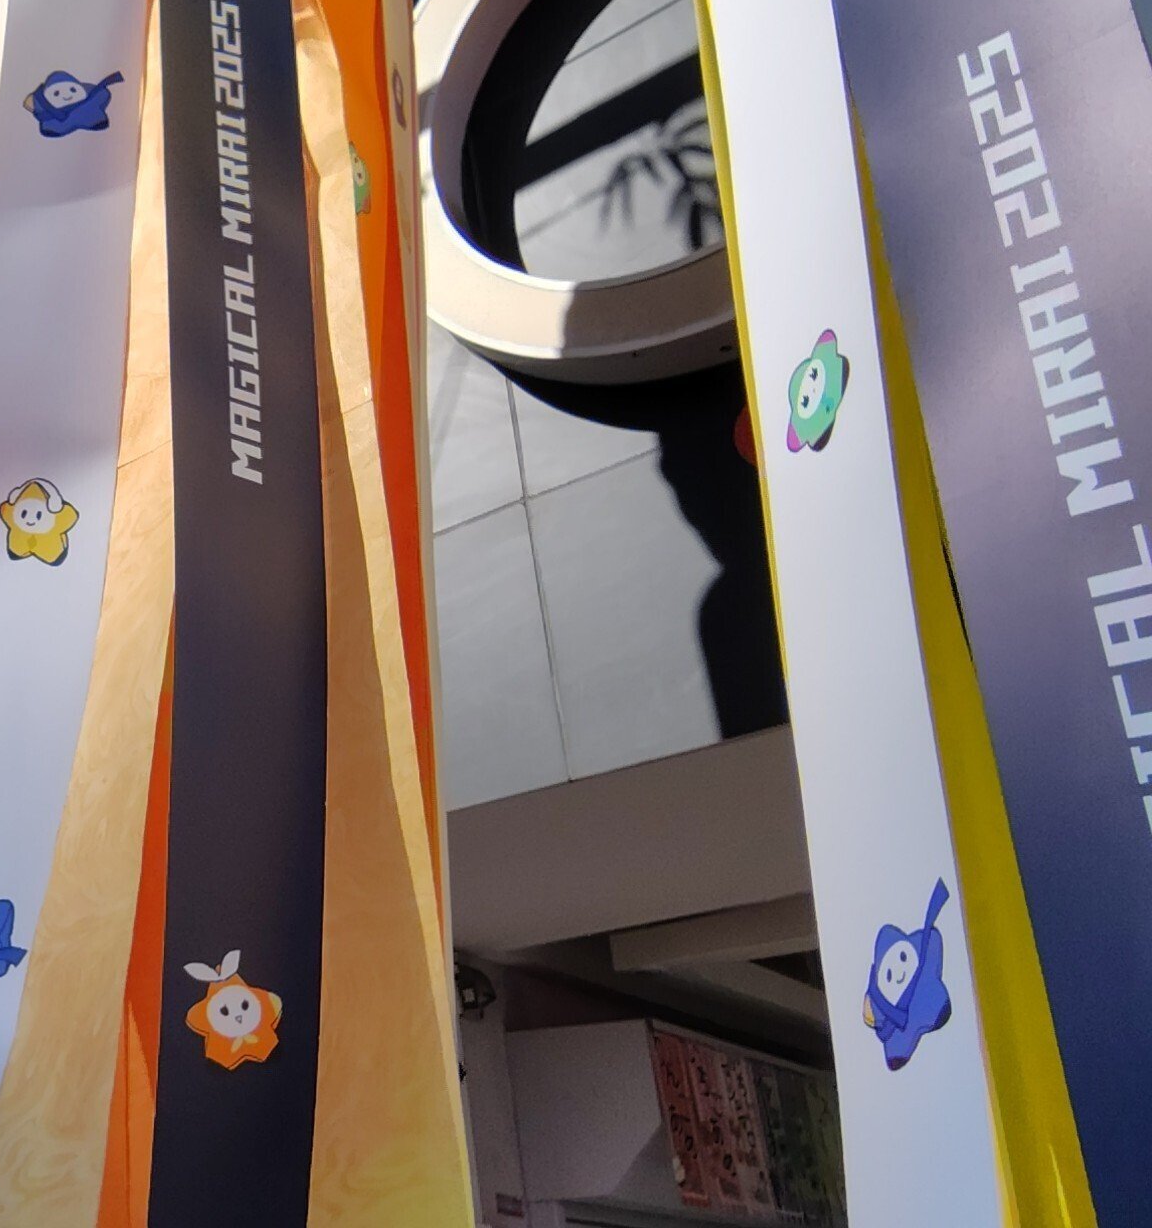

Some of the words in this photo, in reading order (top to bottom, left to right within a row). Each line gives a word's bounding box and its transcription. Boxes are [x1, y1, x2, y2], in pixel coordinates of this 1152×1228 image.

[216, 110, 253, 245] MIRAI
[957, 31, 1061, 247] 2025
[223, 254, 263, 485] MAGICAL
[1010, 245, 1135, 517] MIRAI
